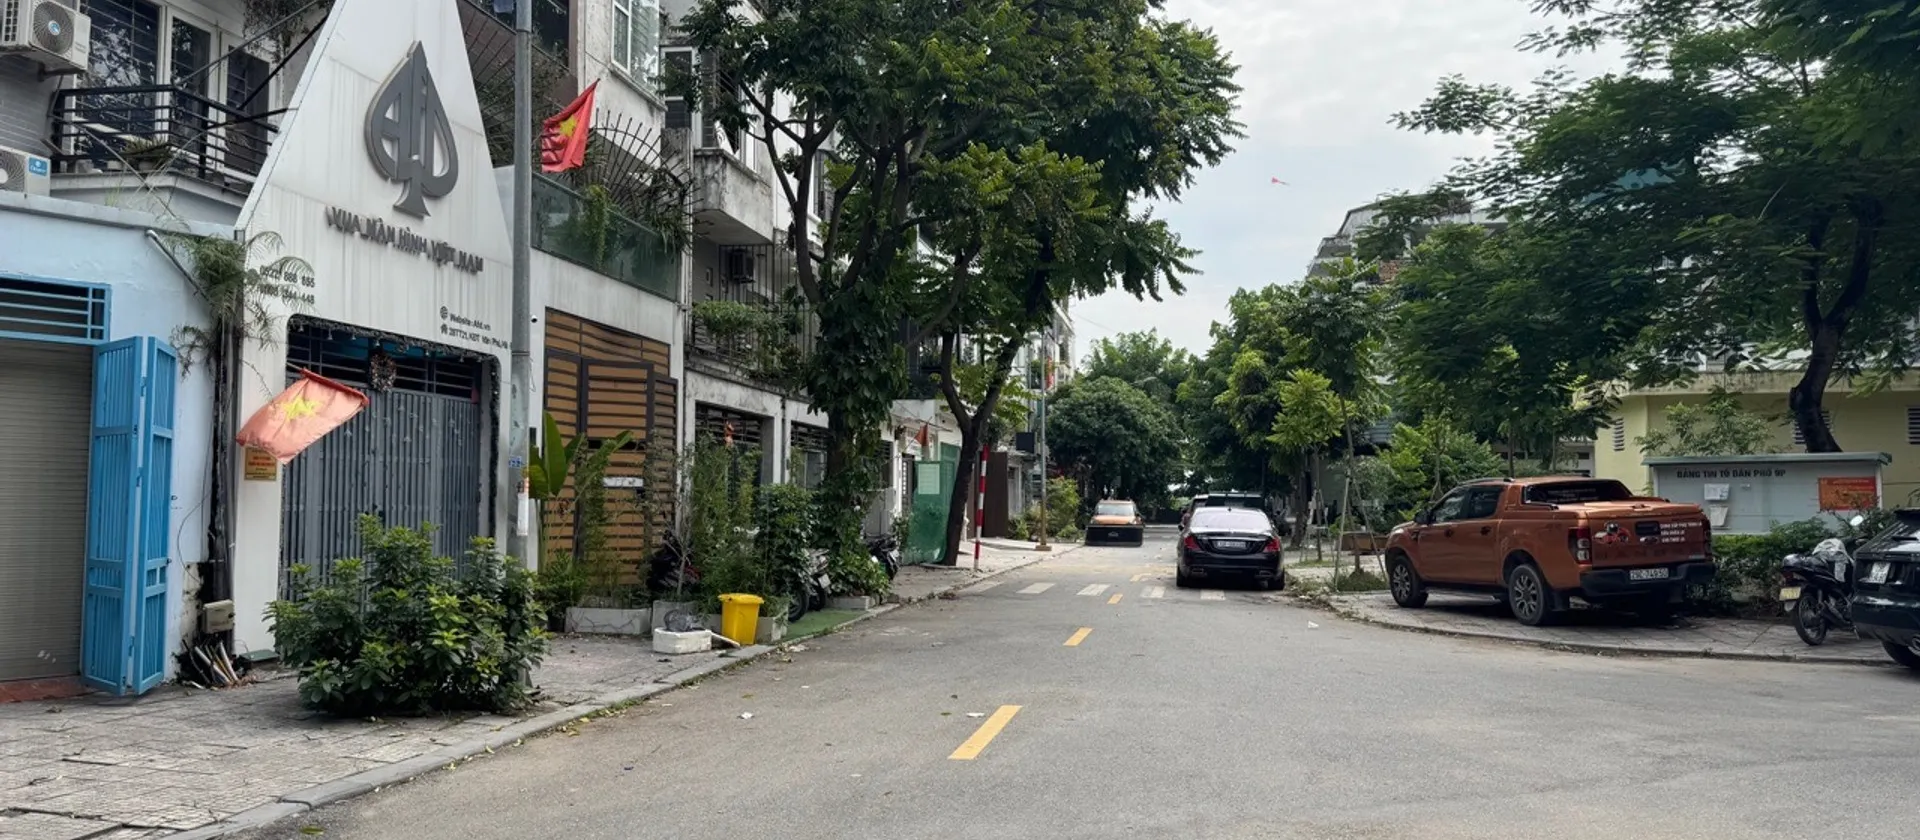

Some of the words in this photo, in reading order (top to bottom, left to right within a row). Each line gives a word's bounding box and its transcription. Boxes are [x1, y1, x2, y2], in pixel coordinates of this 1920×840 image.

[328, 206, 361, 234] VUA
[459, 250, 484, 275] NAM
[1677, 467, 1700, 478] BẢNG
[1703, 469, 1717, 478] TIN
[1732, 468, 1751, 478] DÂN
[1753, 468, 1772, 478] PHỐ
